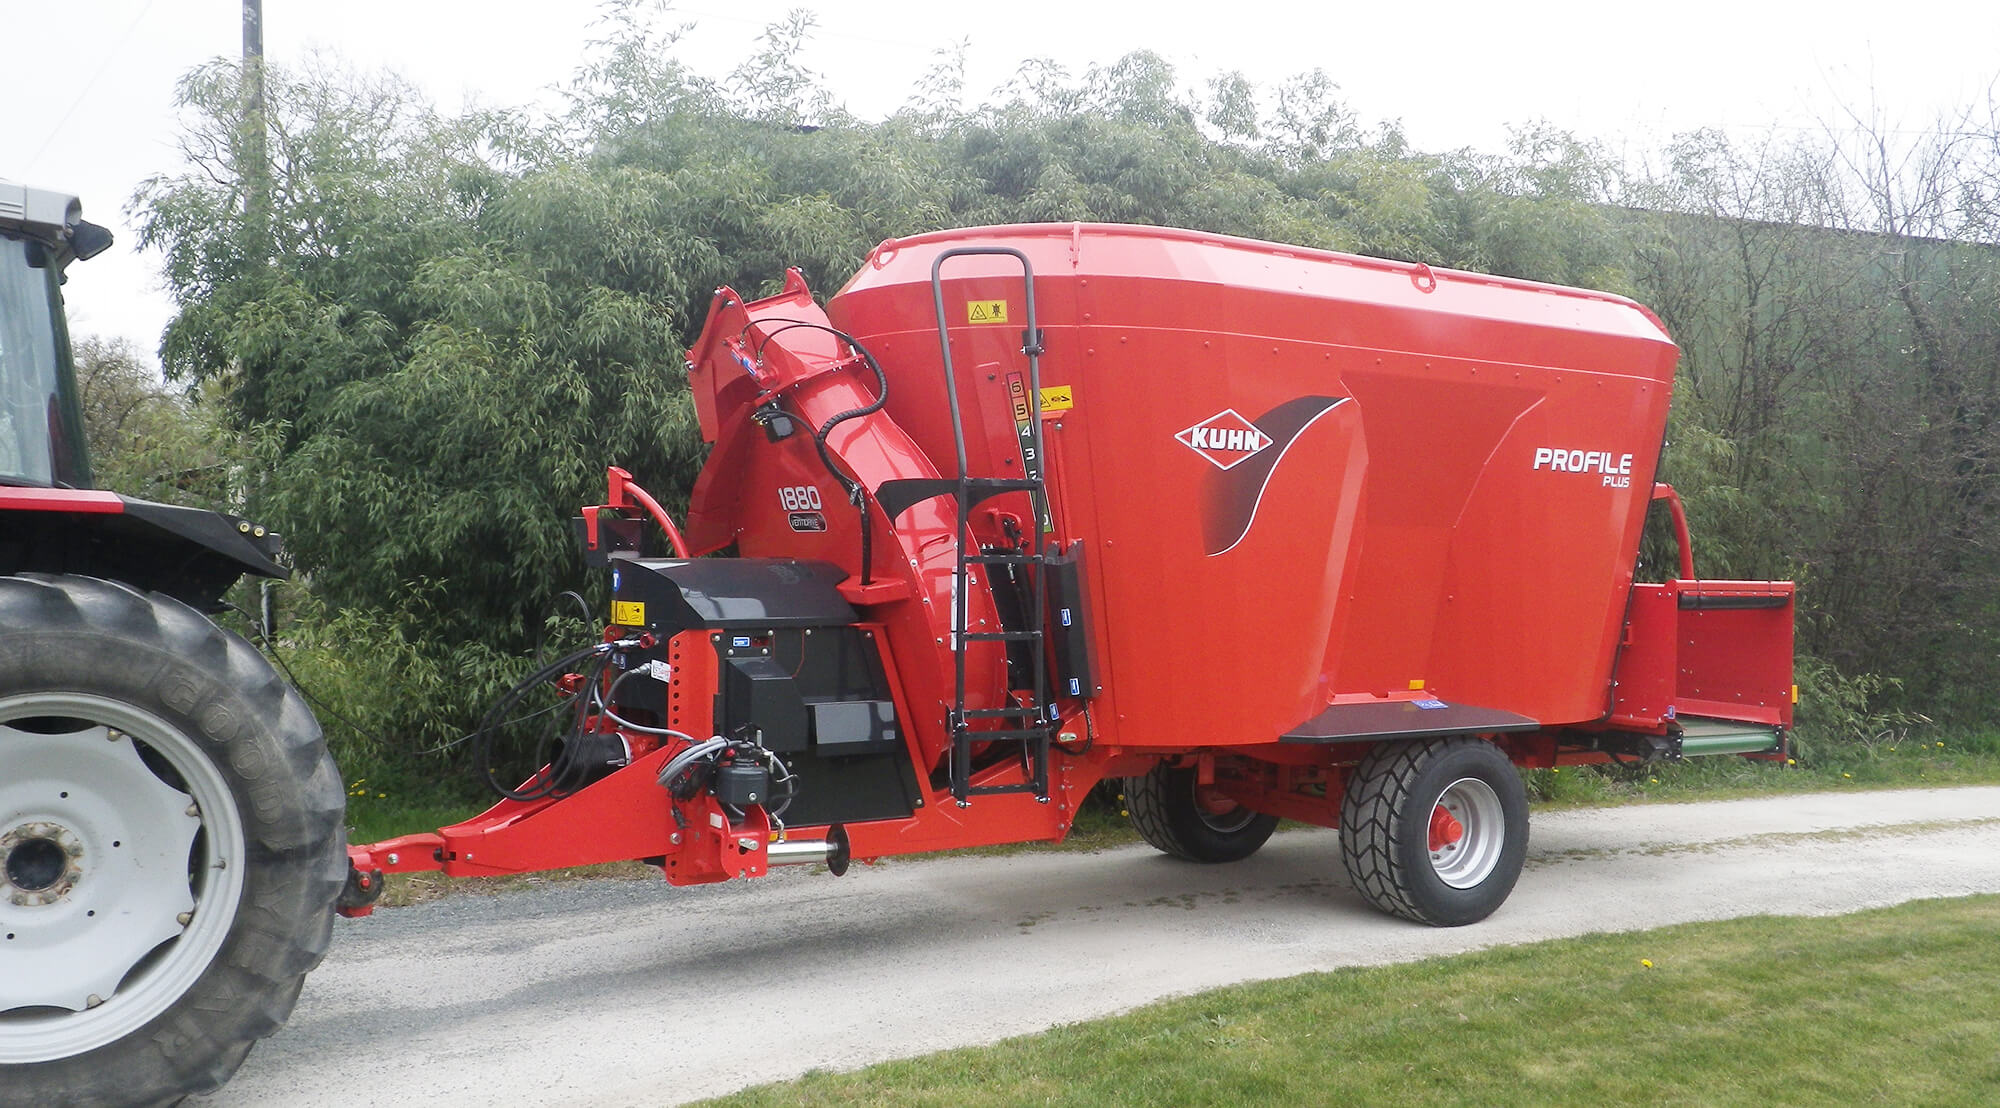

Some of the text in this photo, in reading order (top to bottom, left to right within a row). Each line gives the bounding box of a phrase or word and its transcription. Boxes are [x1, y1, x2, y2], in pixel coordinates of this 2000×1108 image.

[1011, 381, 1022, 393] 6
[1016, 403, 1026, 416] 5
[1021, 426, 1031, 437] 4
[1191, 427, 1260, 451] KUHN
[1025, 448, 1036, 460] 3
[1533, 447, 1633, 475] PROFILE
[1602, 475, 1630, 488] PLUS
[778, 486, 822, 511] 1880
